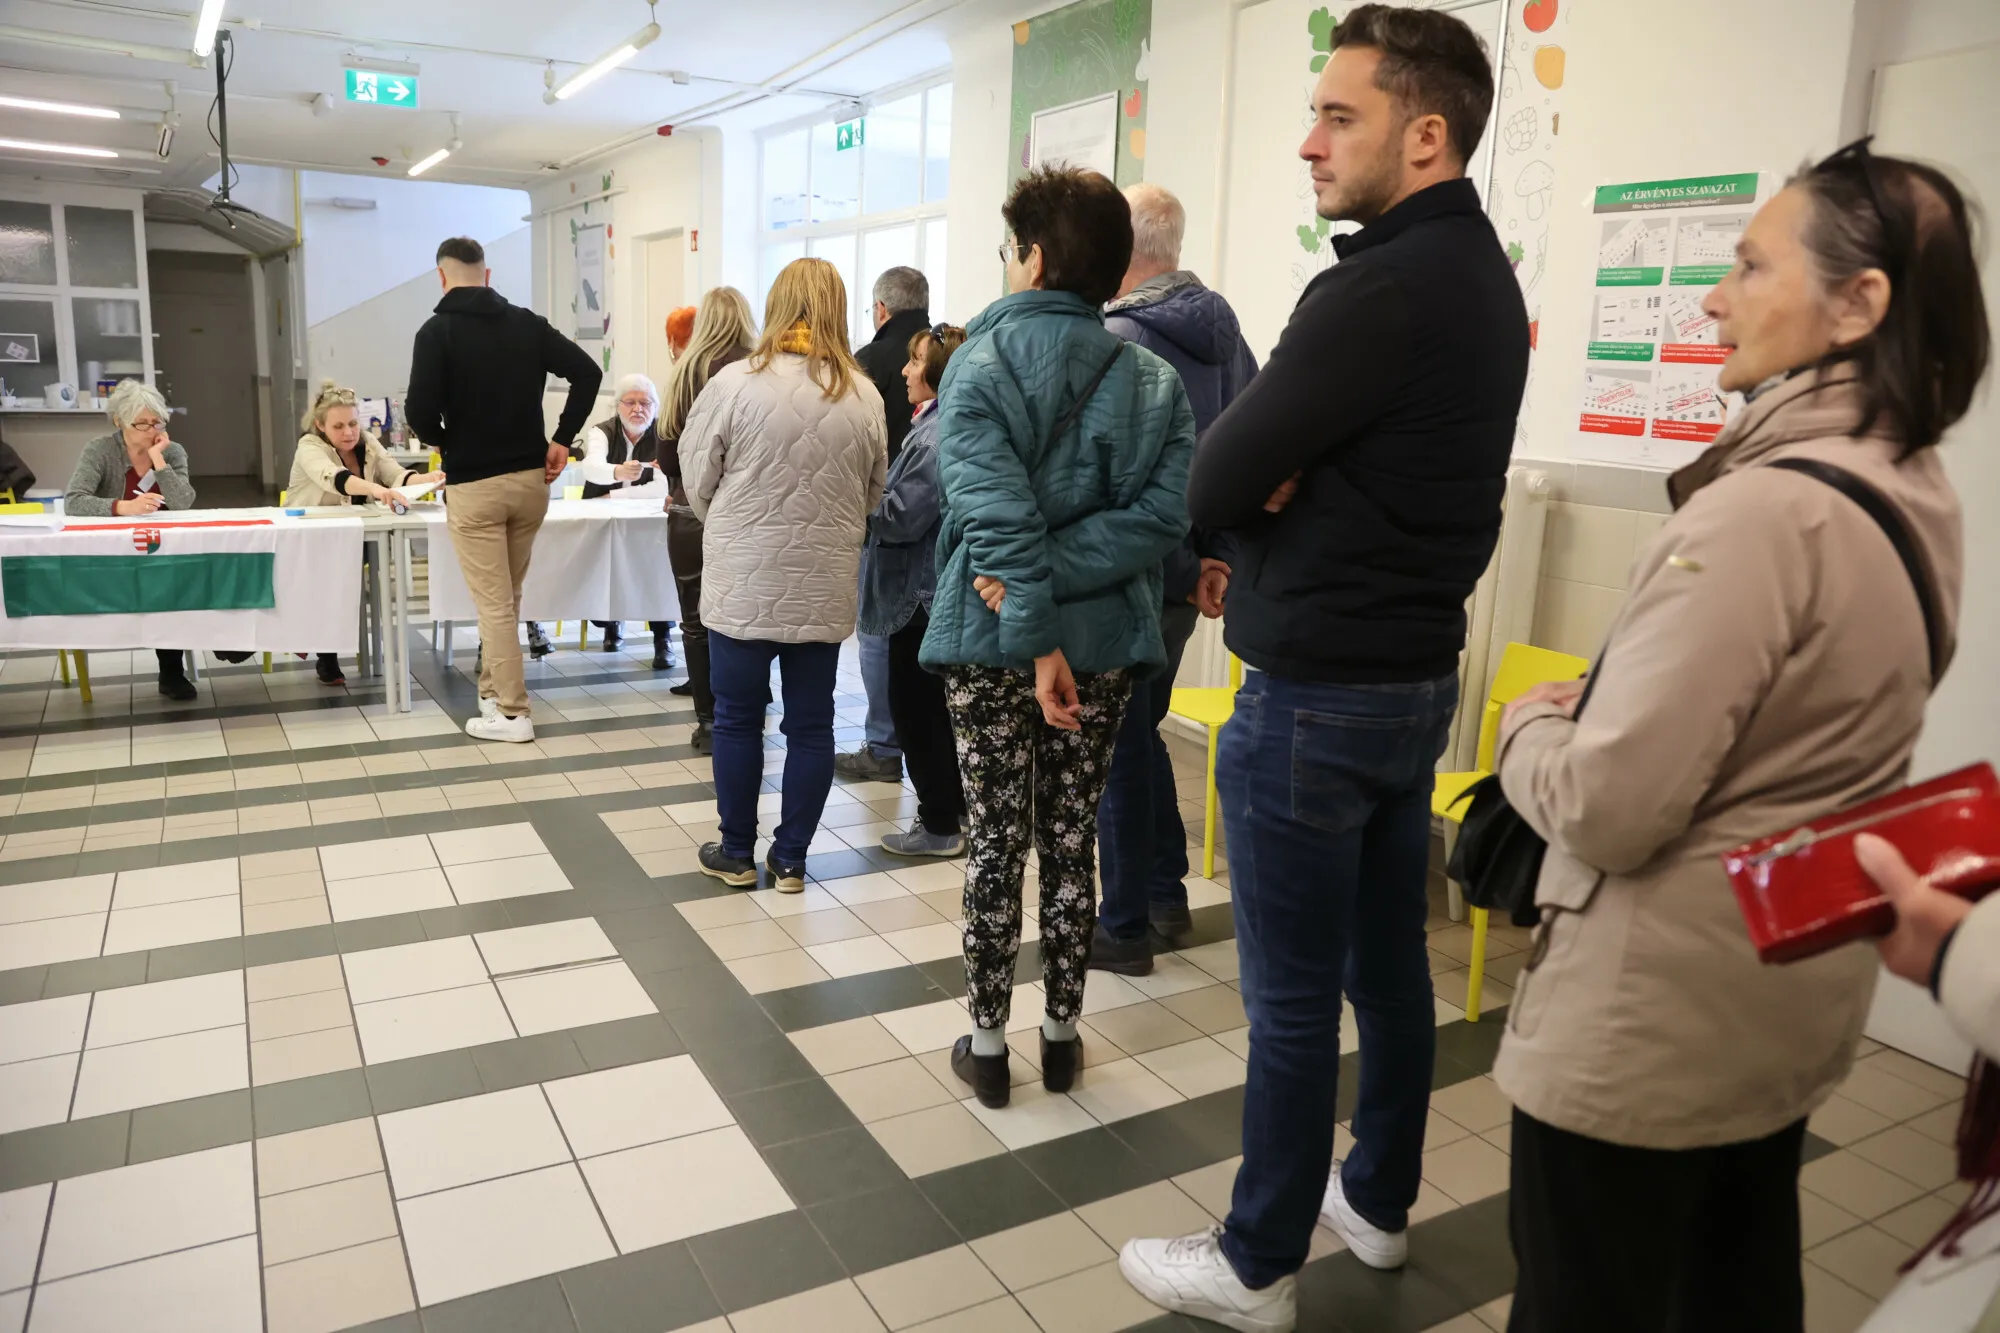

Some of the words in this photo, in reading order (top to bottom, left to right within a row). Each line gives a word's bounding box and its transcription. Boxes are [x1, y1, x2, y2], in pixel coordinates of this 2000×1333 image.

[1620, 191, 1633, 200] AZ
[1635, 187, 1685, 200] ÉRVÉNYES
[1686, 183, 1738, 196] SZAVAZAT
